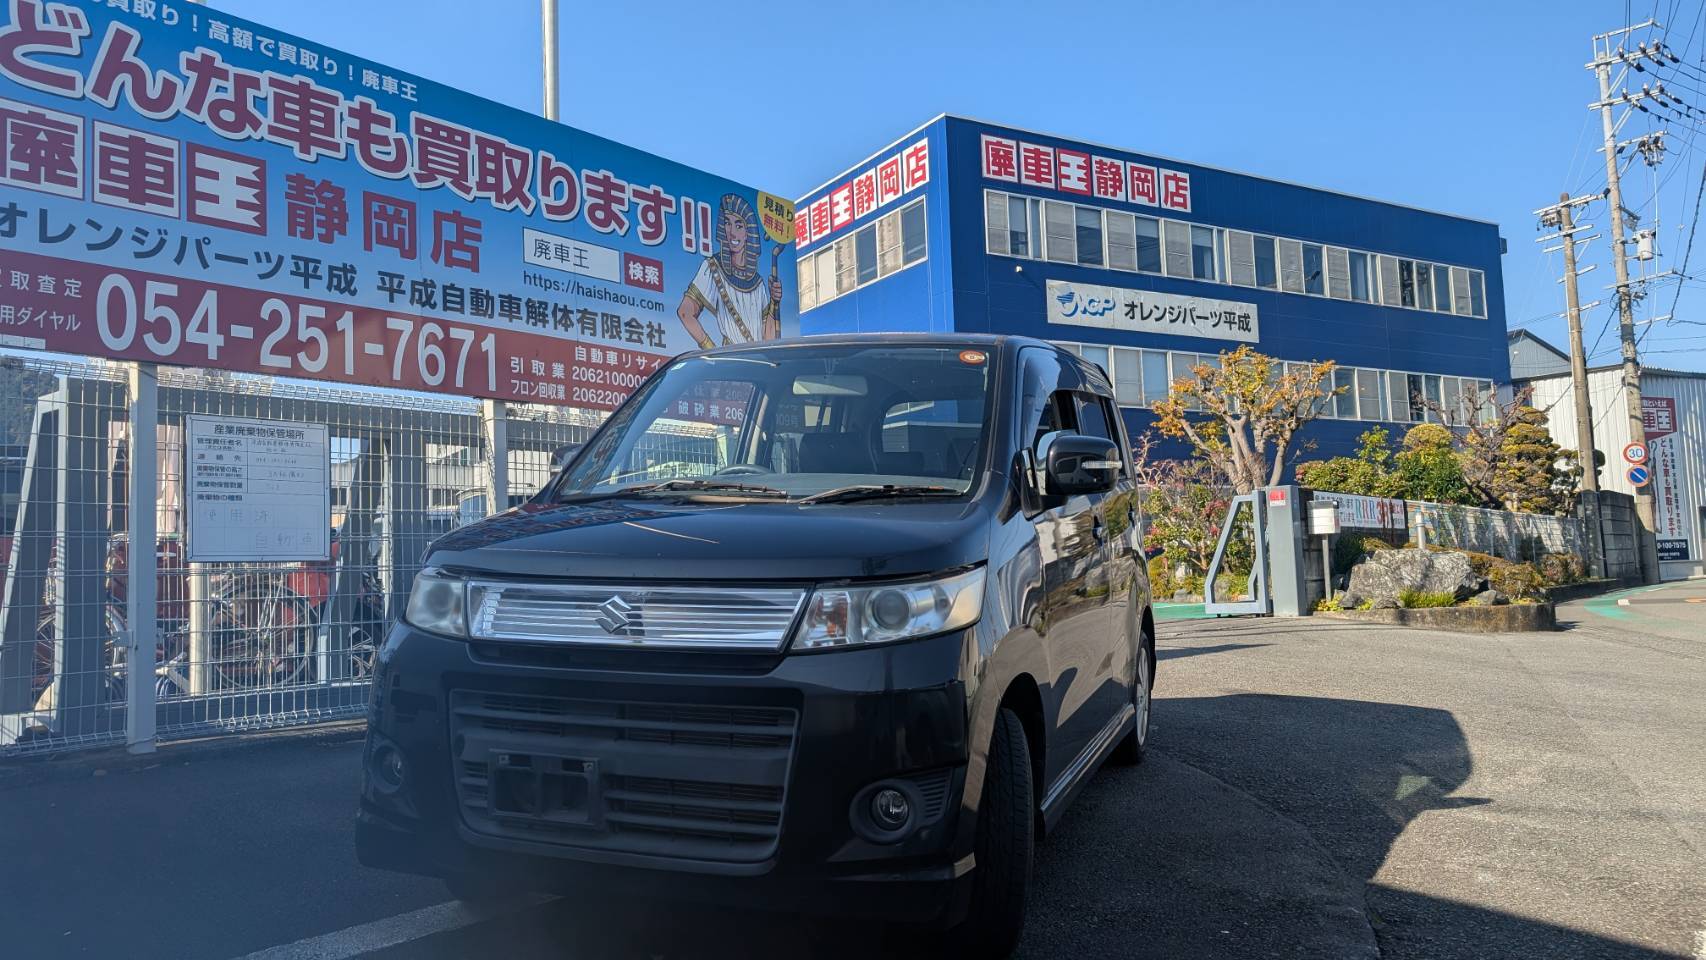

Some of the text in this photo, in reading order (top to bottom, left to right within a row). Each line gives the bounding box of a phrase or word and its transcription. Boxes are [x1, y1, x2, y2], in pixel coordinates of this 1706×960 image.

[984, 140, 1189, 211] 廃車王静岡店
[764, 195, 794, 222] 見積り
[532, 237, 591, 270] 廃車王
[0, 201, 667, 349] オレンジパーツ平成 平成自動車解体有限会社
[0, 268, 82, 298] 取査定
[627, 260, 661, 287] 検索
[523, 270, 665, 313] https://haishaou.com
[1124, 300, 1252, 333] オレンジパーツ平成
[96, 273, 497, 392] 054-251-7671
[510, 356, 565, 379] 引取業
[510, 379, 566, 400] フロン回収業
[678, 400, 720, 418] 破砕業
[214, 424, 305, 440] 産業廃棄物保管場所
[1628, 448, 1643, 459] 30
